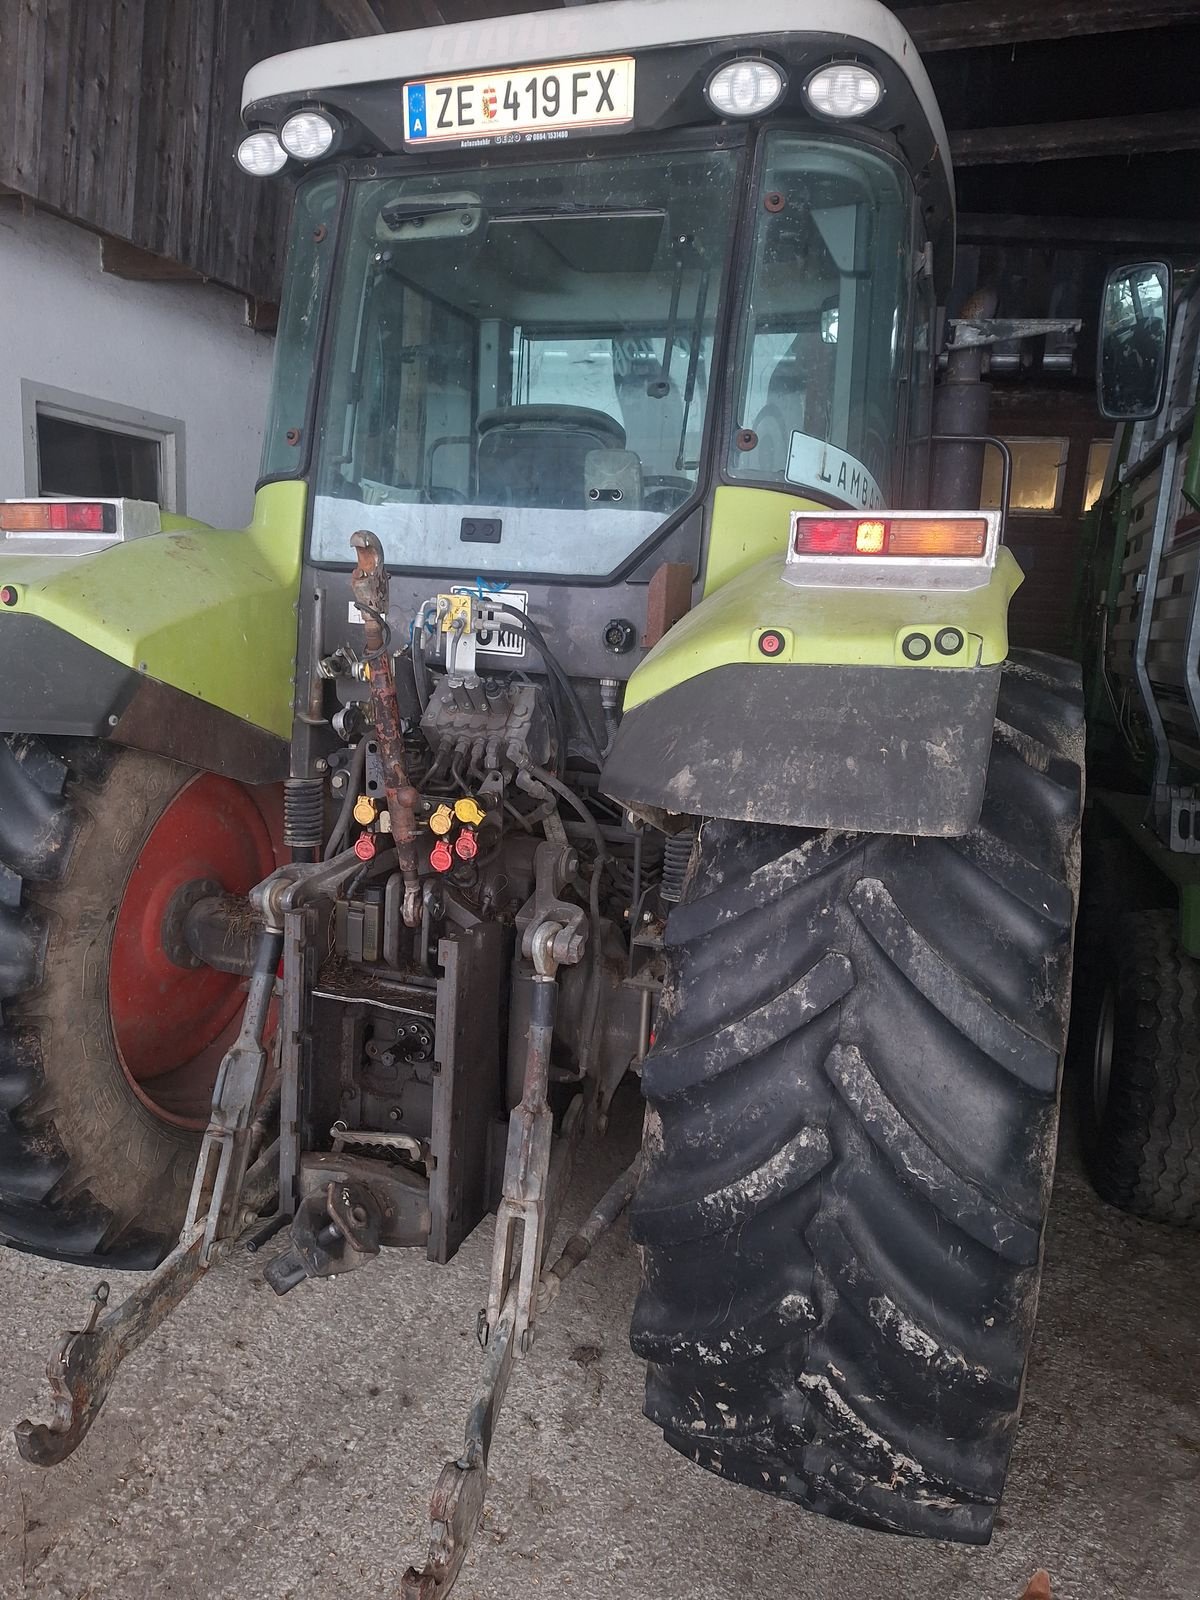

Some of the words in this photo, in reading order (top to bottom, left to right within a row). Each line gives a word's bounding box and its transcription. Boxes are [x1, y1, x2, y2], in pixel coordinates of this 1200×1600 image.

[436, 86, 475, 128] ZE
[503, 75, 560, 121] 419
[572, 69, 616, 114] FX
[413, 119, 423, 132] A
